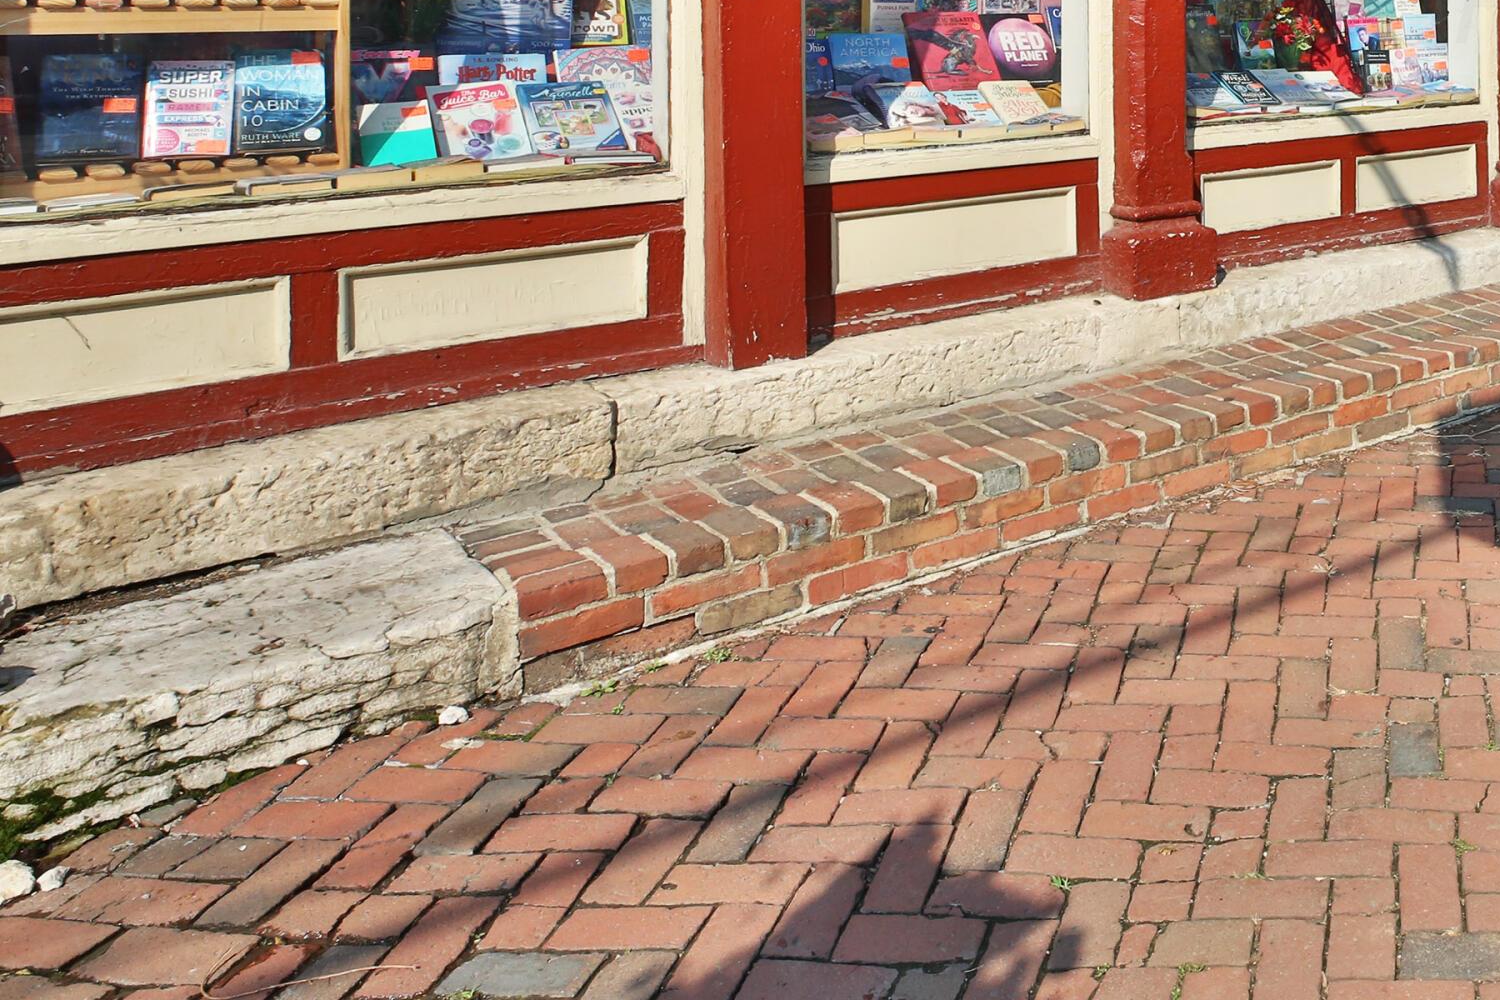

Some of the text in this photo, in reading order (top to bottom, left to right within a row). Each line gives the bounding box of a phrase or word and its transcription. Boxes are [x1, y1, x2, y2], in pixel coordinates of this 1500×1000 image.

[573, 24, 616, 33] rown
[845, 37, 890, 47] NORTH
[999, 32, 1045, 50] RED
[840, 47, 897, 57] AMERICA
[1004, 50, 1049, 62] PLANET
[241, 55, 277, 66] THE
[159, 70, 223, 85] SUPER
[240, 69, 319, 81] WOMAN
[456, 64, 537, 82] Harry Potter
[169, 88, 213, 98] SUSHI
[241, 86, 261, 96] IN
[440, 89, 505, 110] Juice Bar
[167, 103, 210, 111] RAMEN
[241, 99, 299, 112] CABIN
[241, 114, 263, 127] 10
[241, 132, 300, 141] RUTH WARE
